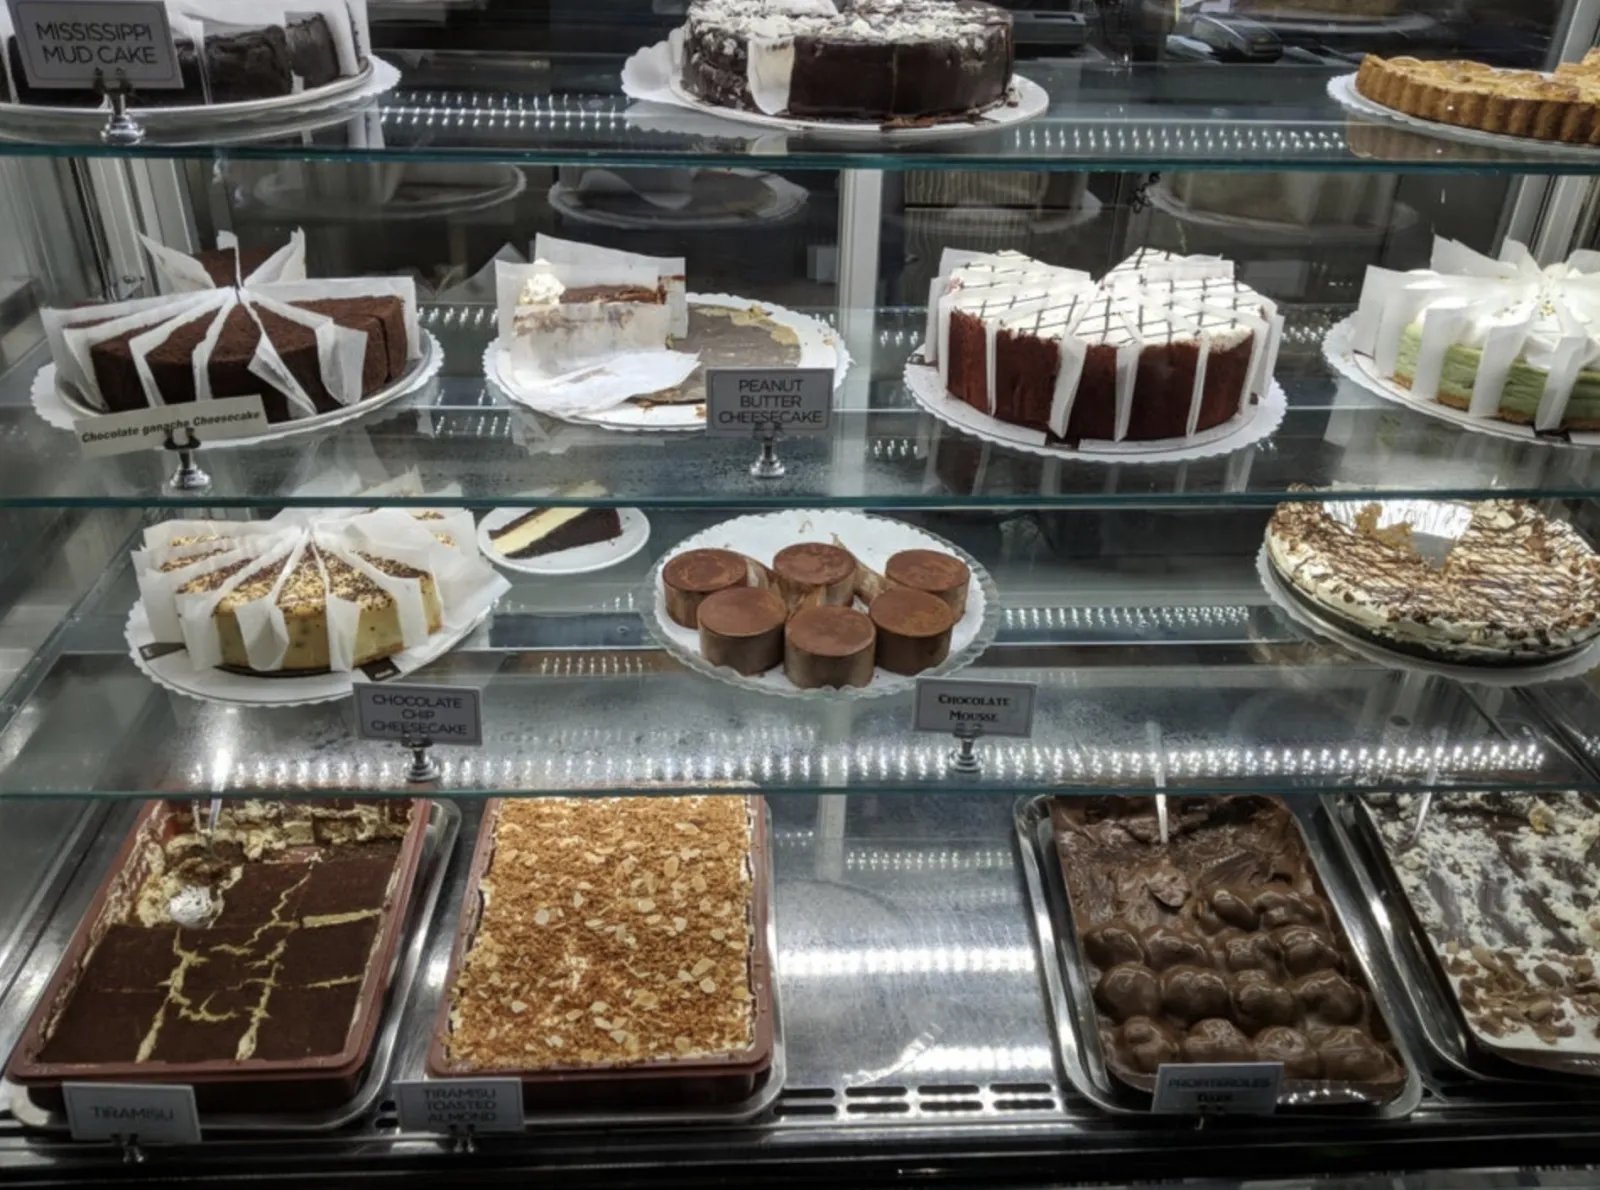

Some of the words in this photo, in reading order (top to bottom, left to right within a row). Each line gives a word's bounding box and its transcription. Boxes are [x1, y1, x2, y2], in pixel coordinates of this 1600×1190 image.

[35, 21, 153, 42] MISSISSIPPI
[42, 45, 94, 65] MUD
[97, 46, 158, 65] CAKE
[738, 379, 804, 393] PEANUT
[740, 395, 802, 409] BUTTER
[718, 410, 822, 424] CHEESECAKE
[81, 428, 139, 443] Chocolate
[142, 419, 190, 436] ganache
[193, 410, 260, 426] Cheesecake
[372, 694, 464, 709] CHOCOLATE
[937, 694, 1011, 706] CHOCOLATE
[402, 708, 435, 720] CHIP
[370, 720, 467, 735] CHEESECAKE
[423, 1088, 496, 1099] TIRAMISU
[425, 1100, 497, 1111] TOASTED
[90, 1106, 174, 1121] TIRAMISU
[427, 1112, 497, 1123] ALMOND
